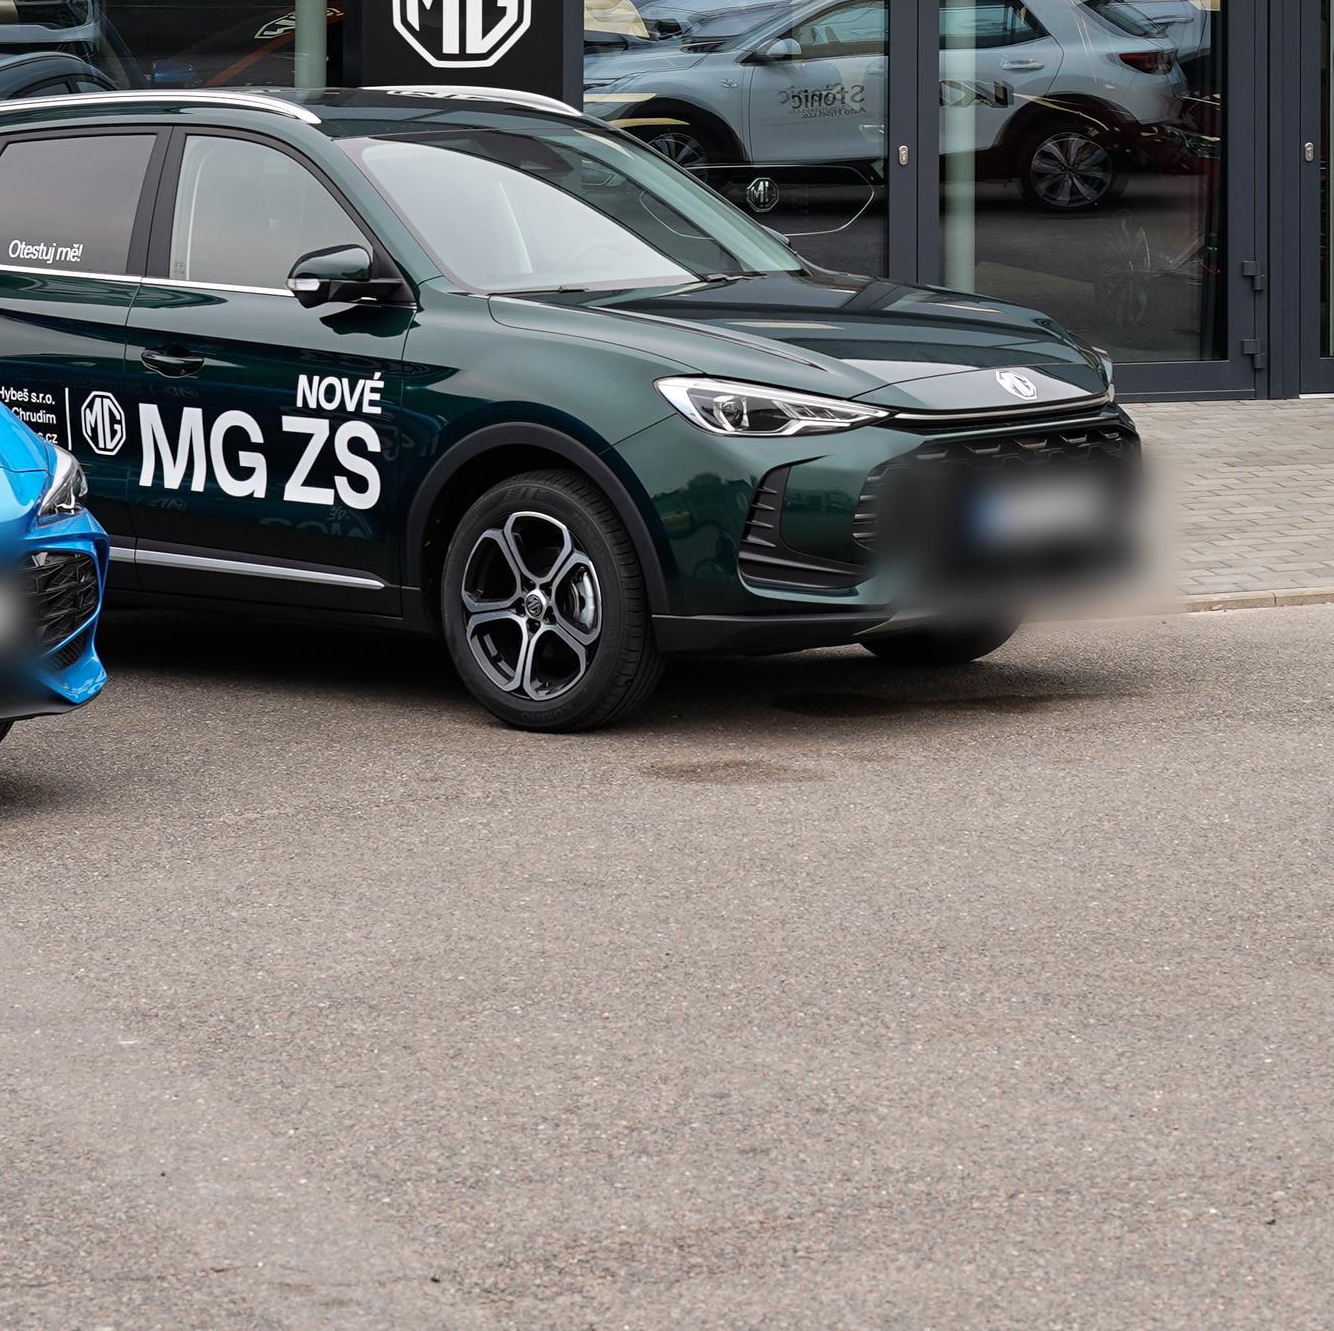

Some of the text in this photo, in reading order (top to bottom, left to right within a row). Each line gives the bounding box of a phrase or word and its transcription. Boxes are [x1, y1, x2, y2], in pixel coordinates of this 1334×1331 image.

[9, 240, 83, 263] Otestuj mě!
[30, 392, 56, 405] s.r.o.
[296, 371, 385, 415] NOVÉ
[11, 406, 57, 424] Chrudim
[85, 397, 122, 450] MG
[138, 402, 382, 510] MG ZS
